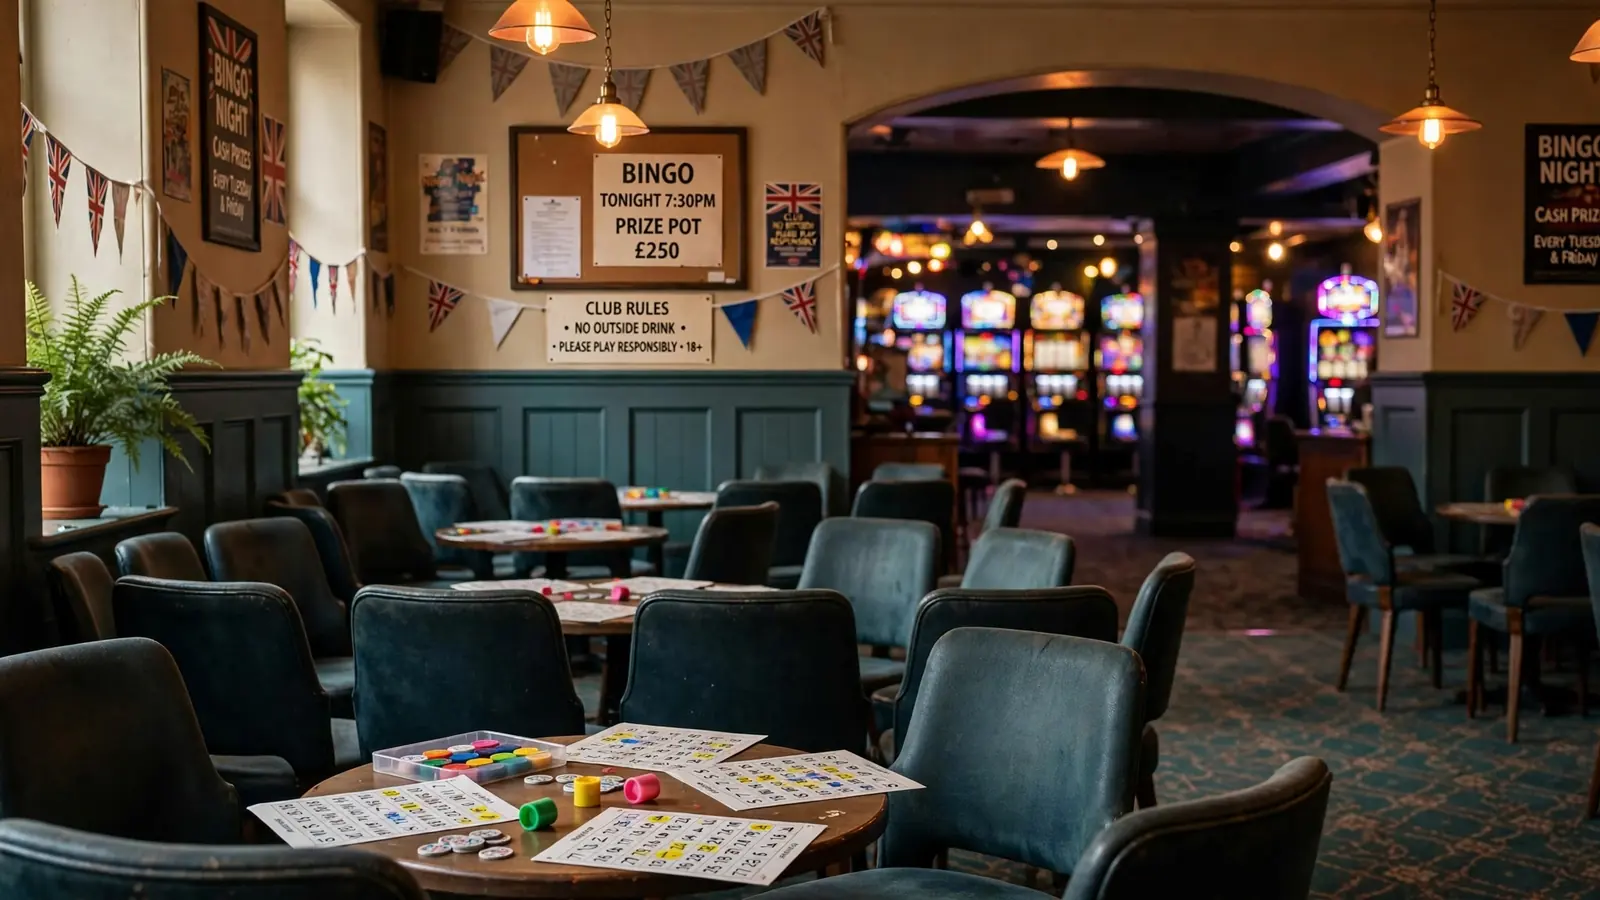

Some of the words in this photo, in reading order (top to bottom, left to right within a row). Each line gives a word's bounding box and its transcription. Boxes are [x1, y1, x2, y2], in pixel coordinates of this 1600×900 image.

[215, 53, 248, 100] BINGO
[216, 93, 248, 137] NIGHT
[623, 163, 693, 184] BINGO
[600, 193, 661, 207] TONIGHT
[665, 194, 715, 207] 7:30PM
[617, 218, 663, 234] PRIZE
[669, 218, 701, 234] POT
[635, 242, 679, 259] £250
[586, 302, 621, 315] CLUB
[627, 302, 669, 315] RULES
[575, 322, 590, 334] NO
[594, 322, 638, 334] OUTSIDE
[643, 322, 675, 333] DRINK
[560, 341, 591, 352] PLEASE
[594, 342, 615, 352] PLAY
[618, 341, 677, 352] RESPONSIBLY
[687, 342, 702, 352] 18+
